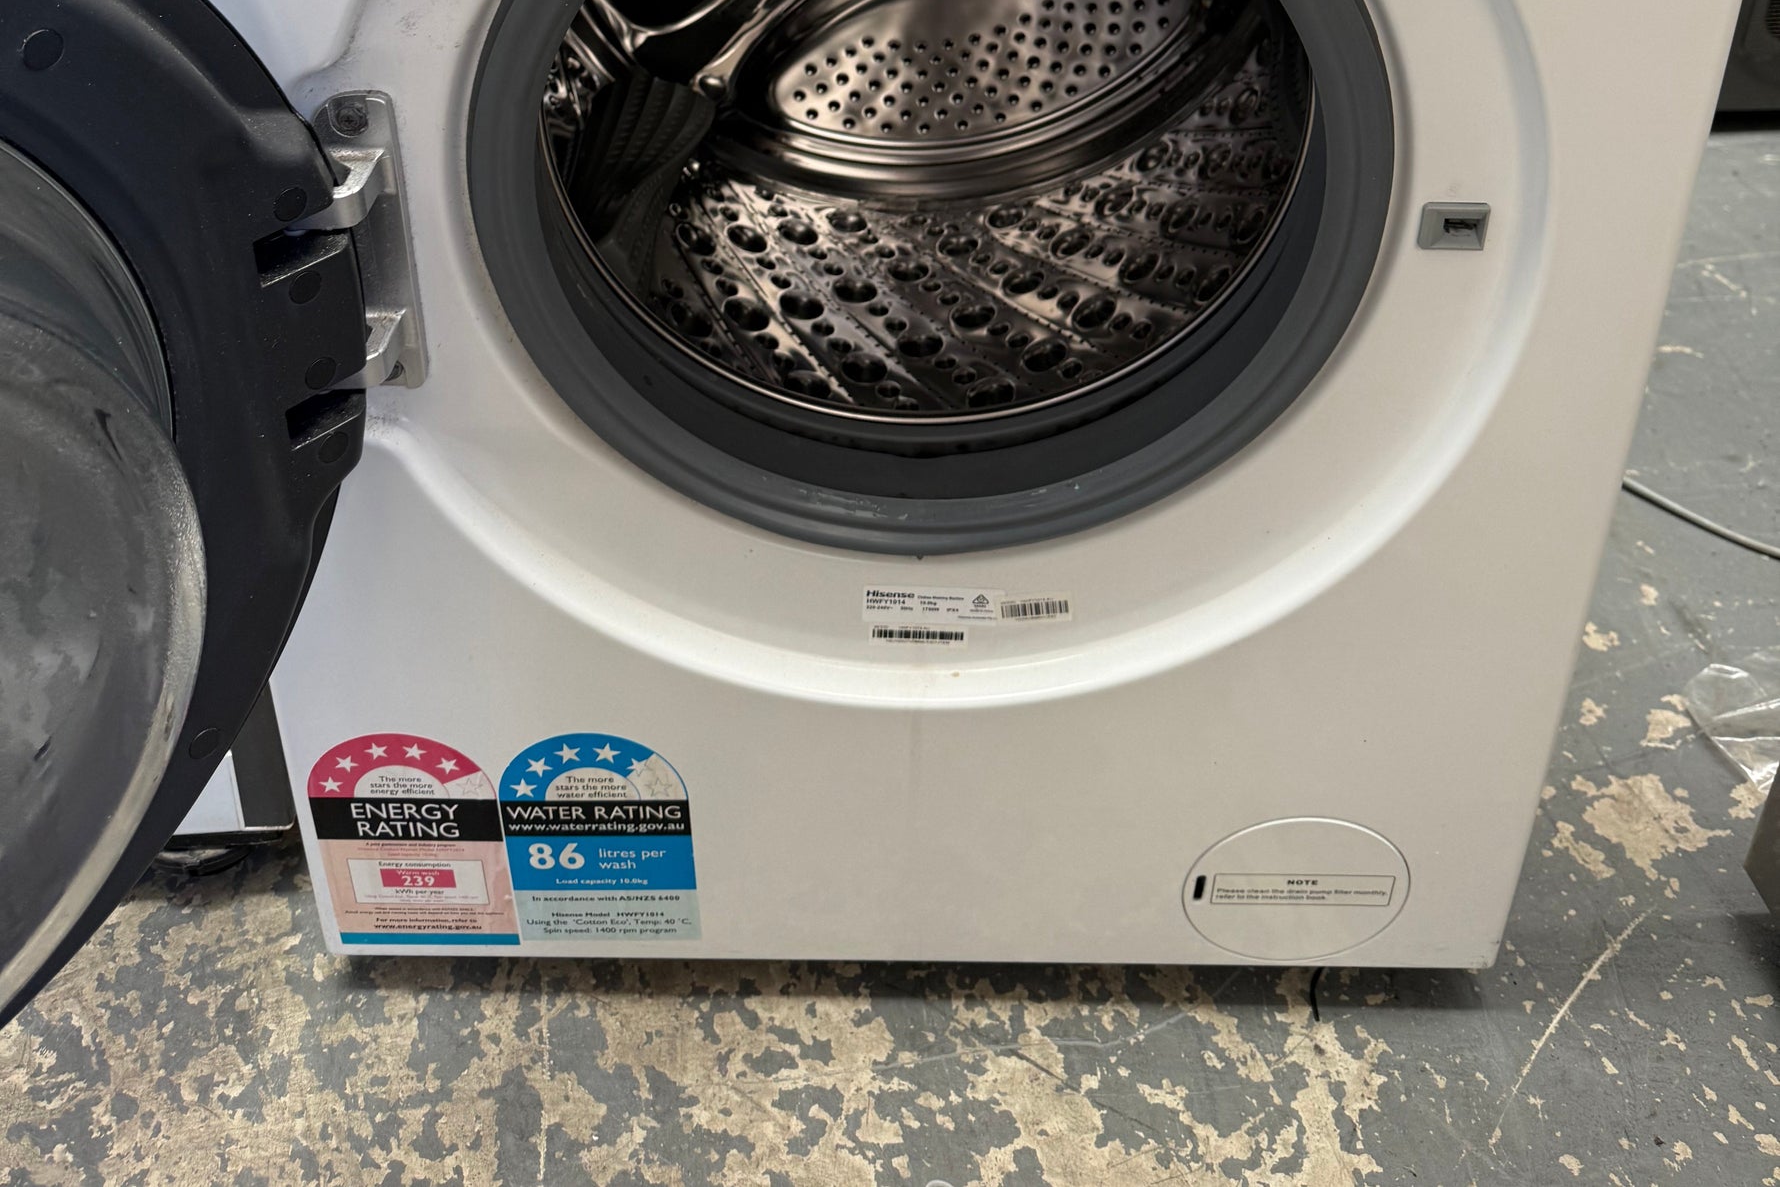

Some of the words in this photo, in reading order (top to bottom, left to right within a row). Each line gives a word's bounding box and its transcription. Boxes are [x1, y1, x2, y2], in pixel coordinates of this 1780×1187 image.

[866, 590, 915, 599] Hisense
[378, 775, 396, 783] The
[566, 775, 584, 783] The
[370, 787, 398, 796] energy
[350, 802, 458, 820] ENERGY
[506, 805, 586, 819] WATER
[594, 805, 681, 820] RATING
[357, 820, 460, 838] RATING
[509, 823, 685, 832] www.waterrating.gov.au
[528, 842, 586, 870] 86
[598, 848, 636, 858] litres
[641, 850, 666, 860] per
[599, 860, 636, 870] wash
[401, 875, 436, 888] 239
[526, 918, 551, 926] Using
[374, 923, 483, 931] www.energyrating.gov.au
[543, 926, 562, 934] Spin
